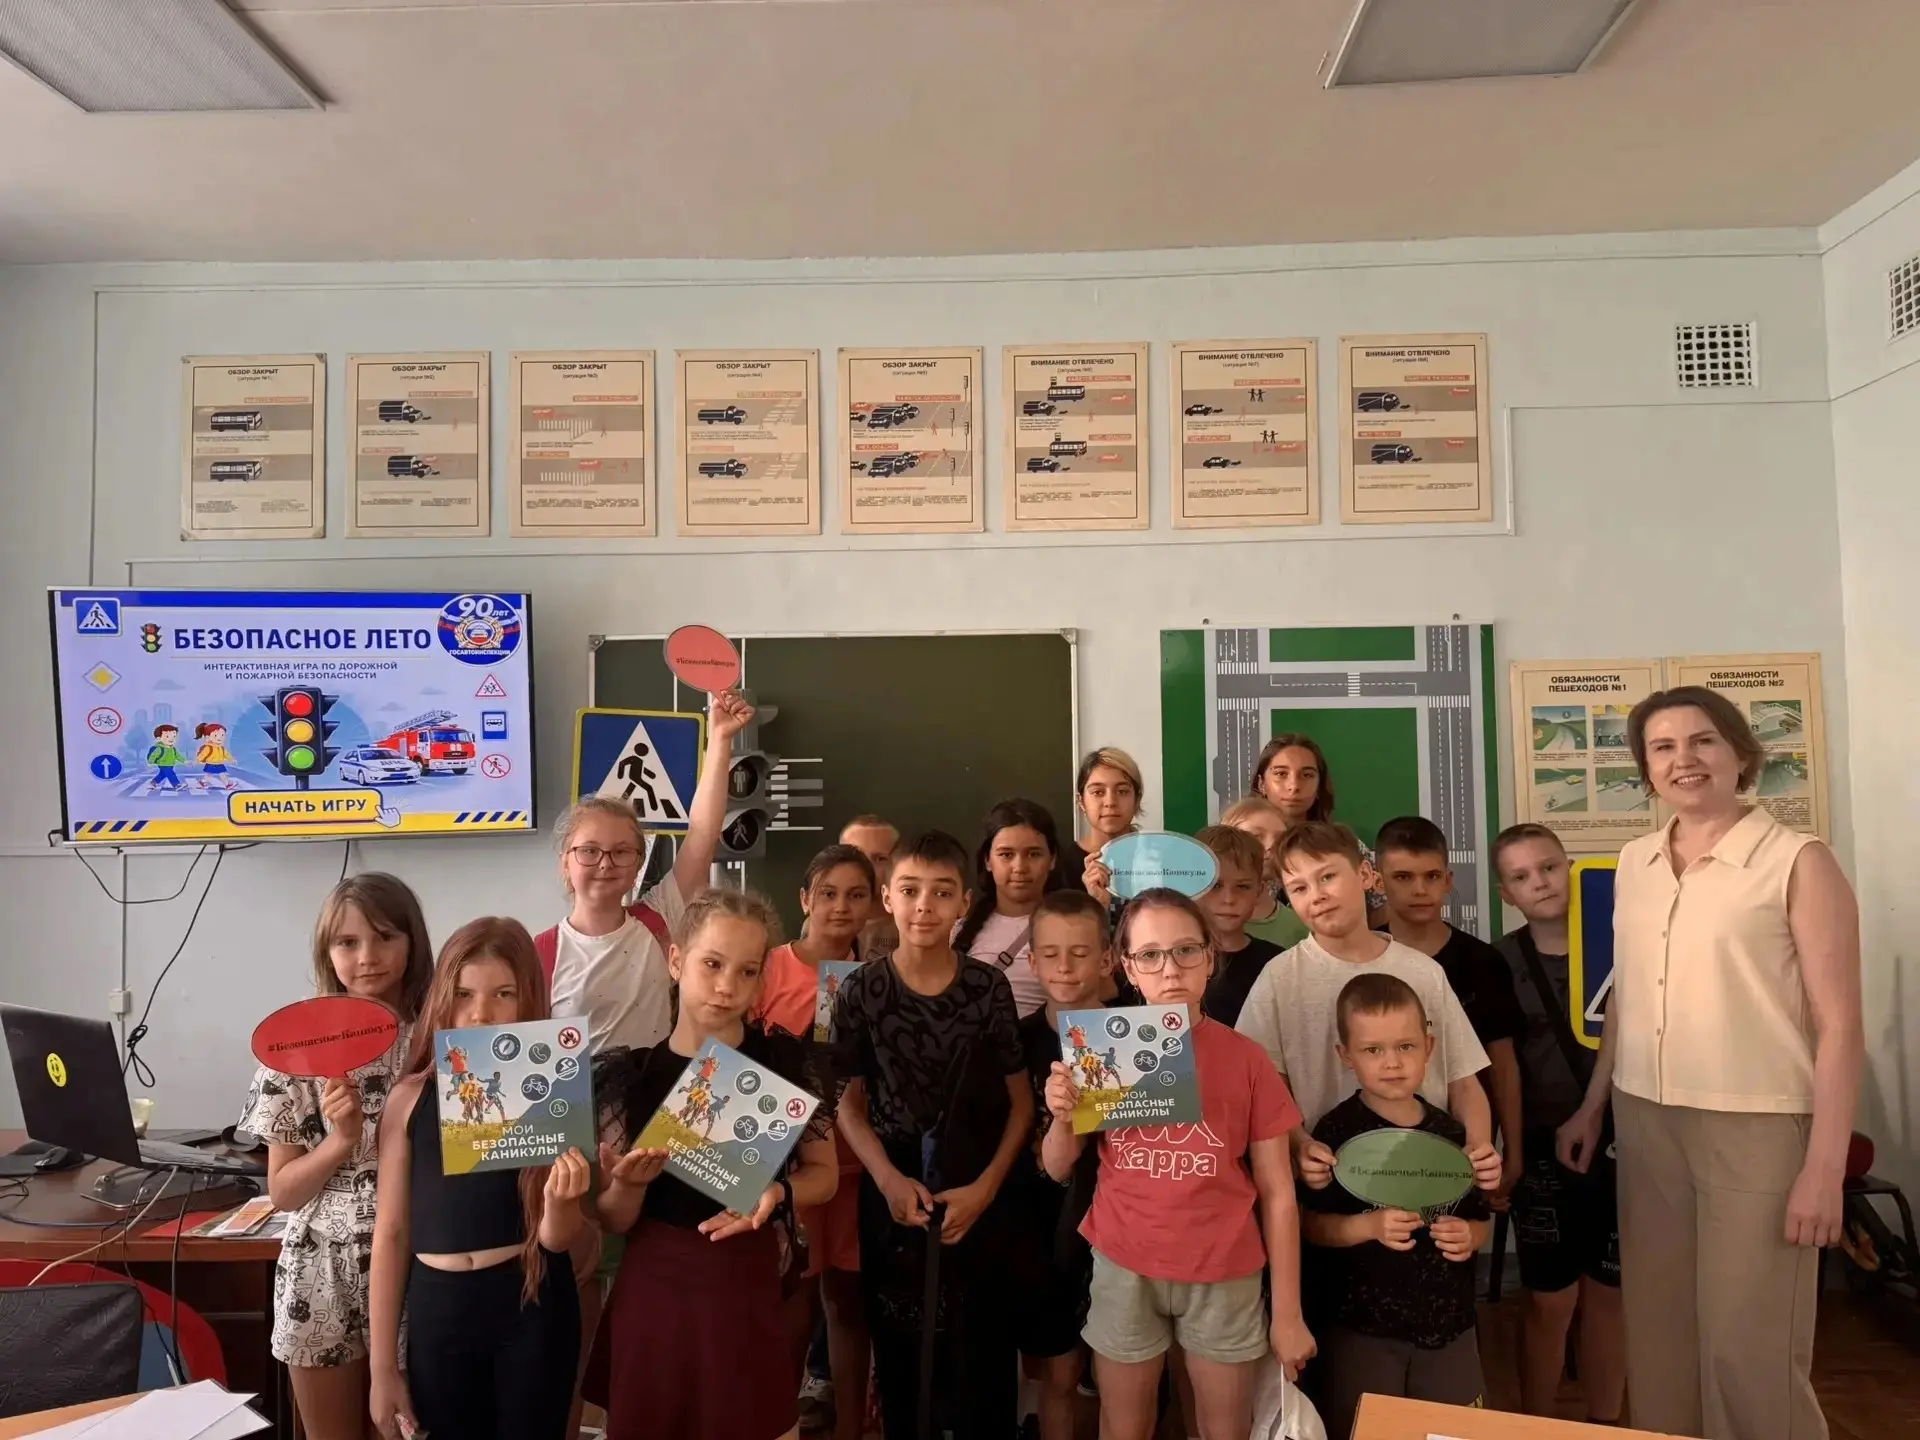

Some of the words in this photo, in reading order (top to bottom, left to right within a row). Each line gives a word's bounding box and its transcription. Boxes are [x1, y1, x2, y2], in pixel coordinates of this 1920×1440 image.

[458, 597, 494, 617] 90
[492, 609, 510, 617] лет
[174, 628, 356, 649] БЕЗОПАСНОЕ
[364, 628, 432, 649] ЛЕТО
[204, 662, 290, 671] ИНТЕРАКТИВНАЯ
[293, 662, 319, 671] ИГРА
[321, 662, 337, 671] ПО
[338, 661, 398, 671] ДОРОЖНОЙ
[235, 671, 295, 680] ПОЖАРНОЙ
[298, 671, 377, 680] БЕЗОПАСНОСТИ
[1551, 674, 1620, 684] ОБЯЗАННОСТИ
[1710, 670, 1779, 680] ОБЯЗАННОСТИ
[1548, 684, 1610, 693] ПЕШЕХОДОВ
[1611, 684, 1627, 692] №1
[1706, 680, 1769, 689] ПЕШЕХОДОВ
[1770, 679, 1784, 687] №2
[244, 797, 317, 814] НАЧАТЬ
[321, 798, 368, 813] ИГРУ
[1120, 1091, 1147, 1100] МОИ
[1095, 1098, 1175, 1112] БЕЗОПАСНЫЕ
[1103, 1108, 1170, 1121] КАНИКУЛЫ
[502, 1124, 534, 1136] МОИ
[472, 1132, 566, 1150] БЕЗОПАСНЫЕ
[481, 1145, 558, 1161] КАНИКУЛЫ
[696, 1141, 723, 1162] МОИ
[666, 1137, 740, 1186] БЕЗОПАСНЫЕ
[1112, 1142, 1217, 1181] Kappa
[668, 1151, 728, 1192] КАНИКУЛЫ
